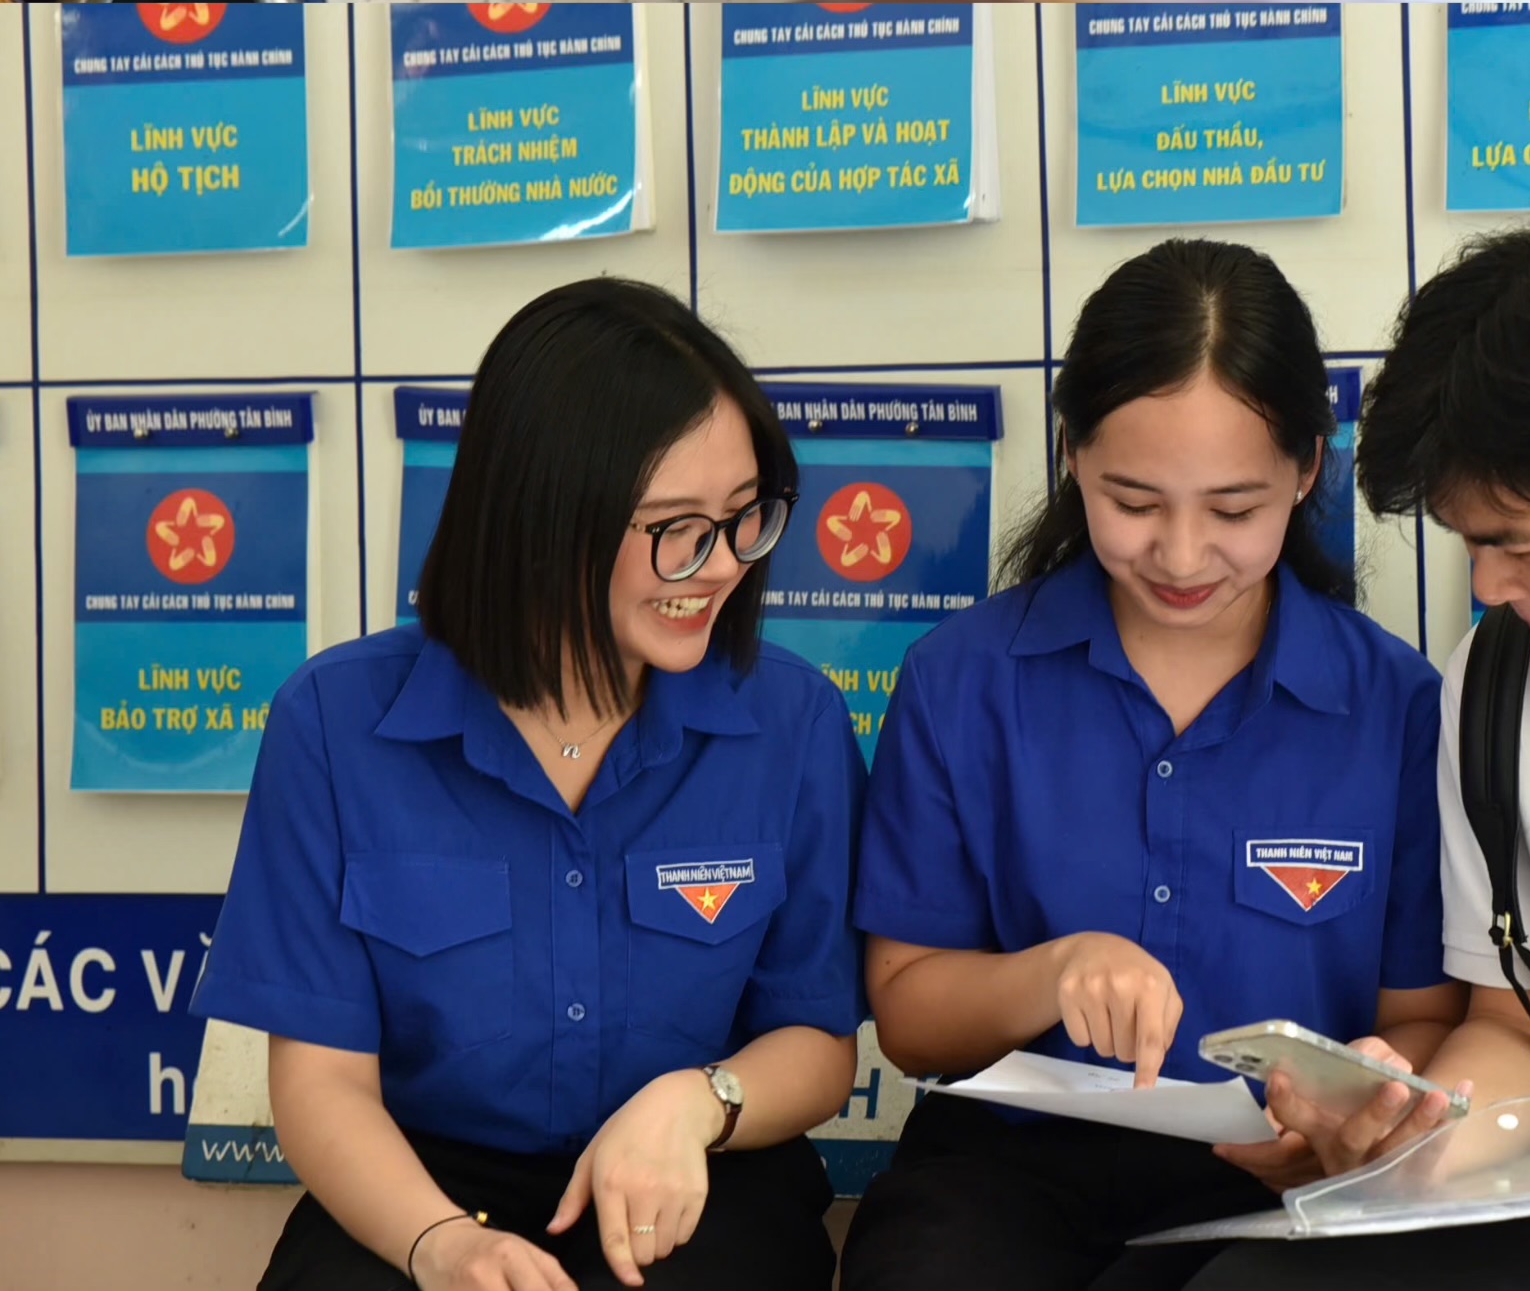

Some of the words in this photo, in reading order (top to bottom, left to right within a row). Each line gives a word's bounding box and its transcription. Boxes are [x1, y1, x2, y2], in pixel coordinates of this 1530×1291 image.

[734, 28, 768, 45] CHUNG
[772, 27, 791, 43] TAY
[816, 22, 844, 40] CÁCH
[872, 21, 892, 39] TỤC
[896, 18, 924, 36] HÀNH
[928, 16, 959, 34] CHÍNH
[1089, 18, 1125, 35] CHUNG
[1129, 17, 1149, 33] TAY
[1176, 13, 1206, 30] CÁCH
[1235, 12, 1256, 30] TỤC
[1260, 9, 1290, 26] HÀNH
[1294, 6, 1327, 25] CHÍNH
[801, 86, 844, 111] LĨNH
[851, 84, 889, 110] VỰC
[1161, 80, 1208, 104] LĨNH
[1215, 78, 1256, 105] VỰC
[468, 107, 513, 131] LĨNH
[520, 103, 560, 129] VỰC
[131, 123, 184, 151] LĨNH
[192, 121, 238, 153] VỰC
[741, 122, 809, 151] THÀNH
[817, 120, 856, 151] LẬP
[862, 117, 888, 146] VÀ
[896, 119, 950, 146] HOẠT
[1157, 124, 1197, 151] ĐẤU
[452, 141, 512, 166] TRÁCH
[518, 135, 578, 163] NHIỆM
[1471, 141, 1517, 171] LỰA
[131, 160, 169, 196] HỘ
[178, 164, 240, 195] TỊCH
[448, 179, 520, 206] THƯỜNG
[526, 174, 562, 201] NHÀ
[569, 171, 618, 198] NƯỚC
[729, 167, 785, 198] ĐỘNG
[791, 162, 832, 192] CỦA
[839, 163, 881, 193] HỢP
[887, 161, 927, 189] TÁC
[934, 158, 960, 185] XÃ
[1097, 168, 1136, 194] LỰA
[1142, 167, 1196, 191] CHỌN
[1203, 162, 1243, 186] NHÀ
[1298, 160, 1326, 182] TƯ
[86, 409, 103, 433] ỦY
[105, 413, 127, 431] BAN
[130, 408, 161, 431] NHÂN
[164, 408, 188, 429] DÂN
[190, 407, 237, 429] PHƯỜNG
[239, 406, 262, 428] TÂN
[264, 405, 292, 428] BÌNH
[437, 409, 460, 427] BAN
[778, 402, 801, 420] BAN
[805, 398, 838, 421] NHÂN
[841, 399, 866, 419] DÂN
[869, 400, 918, 421] PHƯỜNG
[921, 399, 945, 422] TÂN
[948, 400, 978, 422] BÌNH
[789, 591, 808, 606] TAY
[833, 589, 861, 607] CÁCH
[888, 593, 908, 611] TỤC
[912, 592, 940, 610] HÀNH
[138, 663, 189, 691] LĨNH
[197, 665, 241, 694] VỰC
[101, 700, 146, 730] BẢO
[152, 704, 199, 734] TRỢ
[205, 703, 234, 730] XÃ
[1256, 847, 1287, 858] THANH
[1289, 845, 1312, 859] NIÊN
[1314, 847, 1331, 862] VIỆT
[1334, 850, 1353, 861] NAM
[661, 870, 690, 883] THANH
[729, 866, 750, 879] NAM
[0, 930, 116, 1013] ÁC
